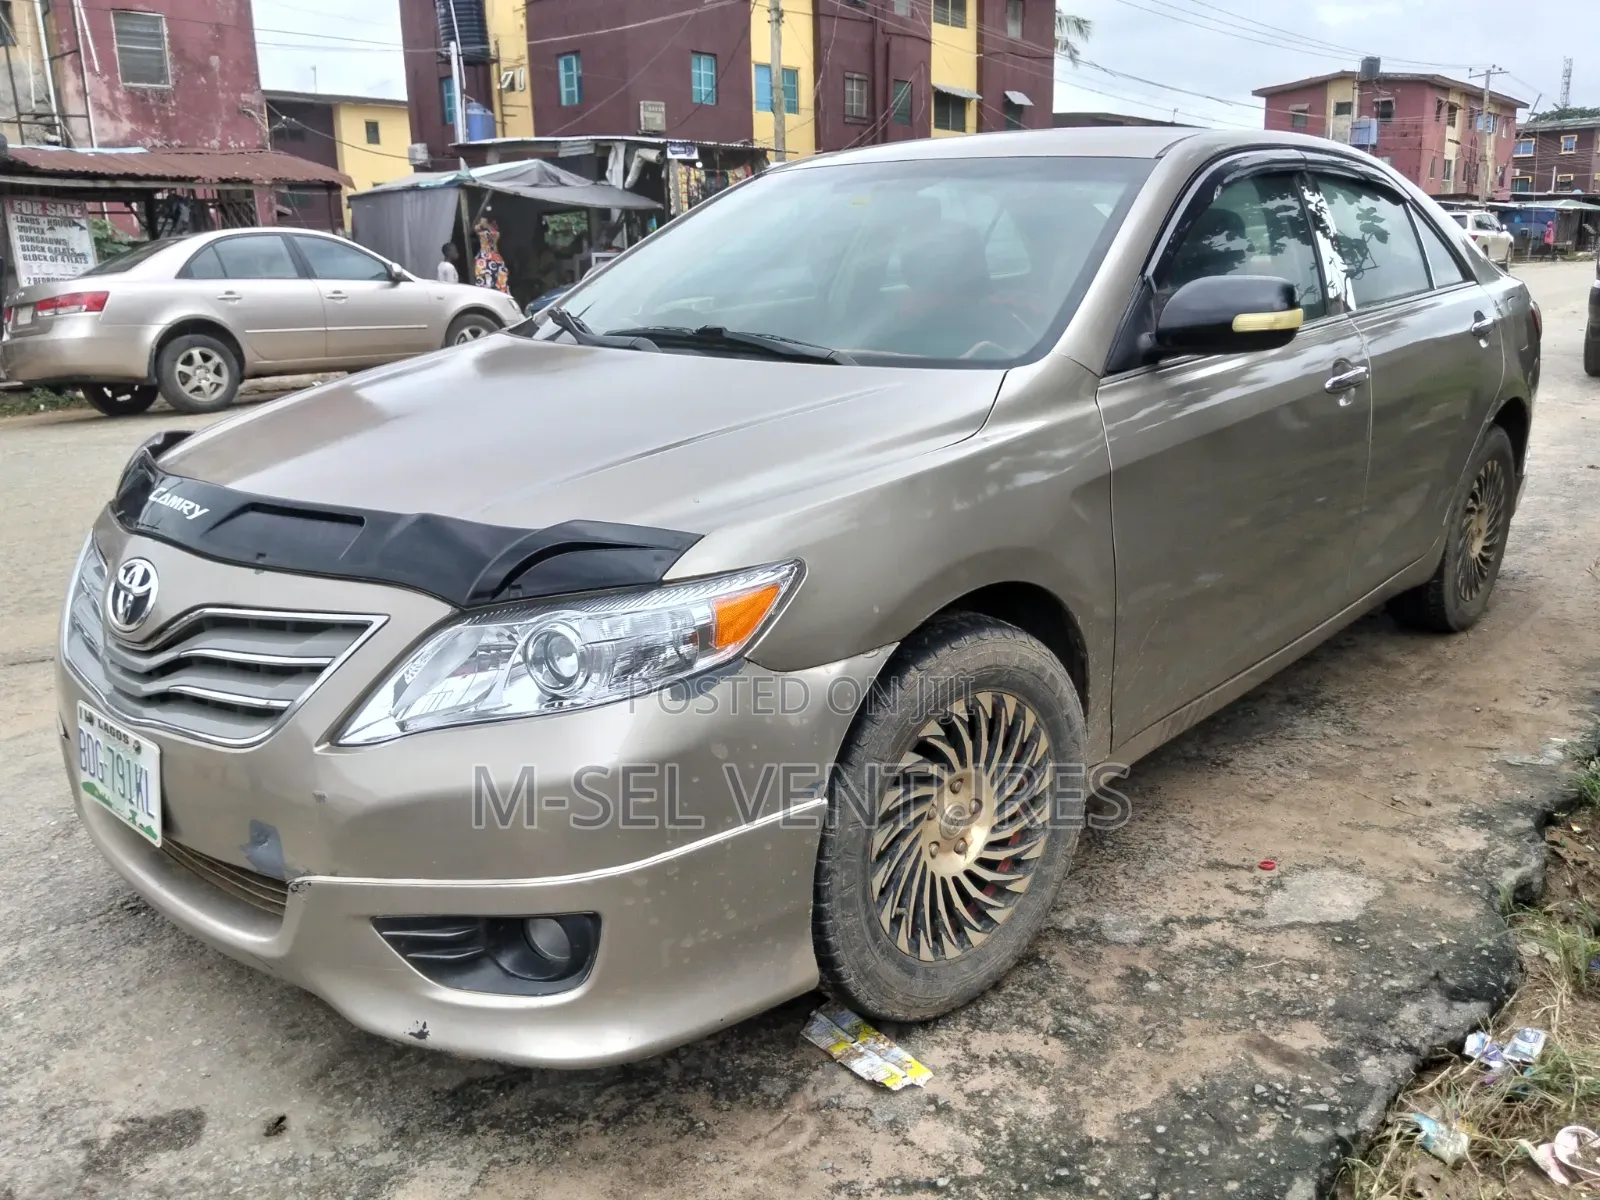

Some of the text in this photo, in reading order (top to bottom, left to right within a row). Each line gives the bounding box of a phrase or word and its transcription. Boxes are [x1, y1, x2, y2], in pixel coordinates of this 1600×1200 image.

[13, 199, 82, 218] FOR SALE
[17, 225, 46, 235] DUPLEX
[20, 244, 46, 253] BLOCK
[22, 253, 49, 262] BLOCK
[148, 486, 210, 520] CAMRY
[98, 718, 130, 745] LAGOS
